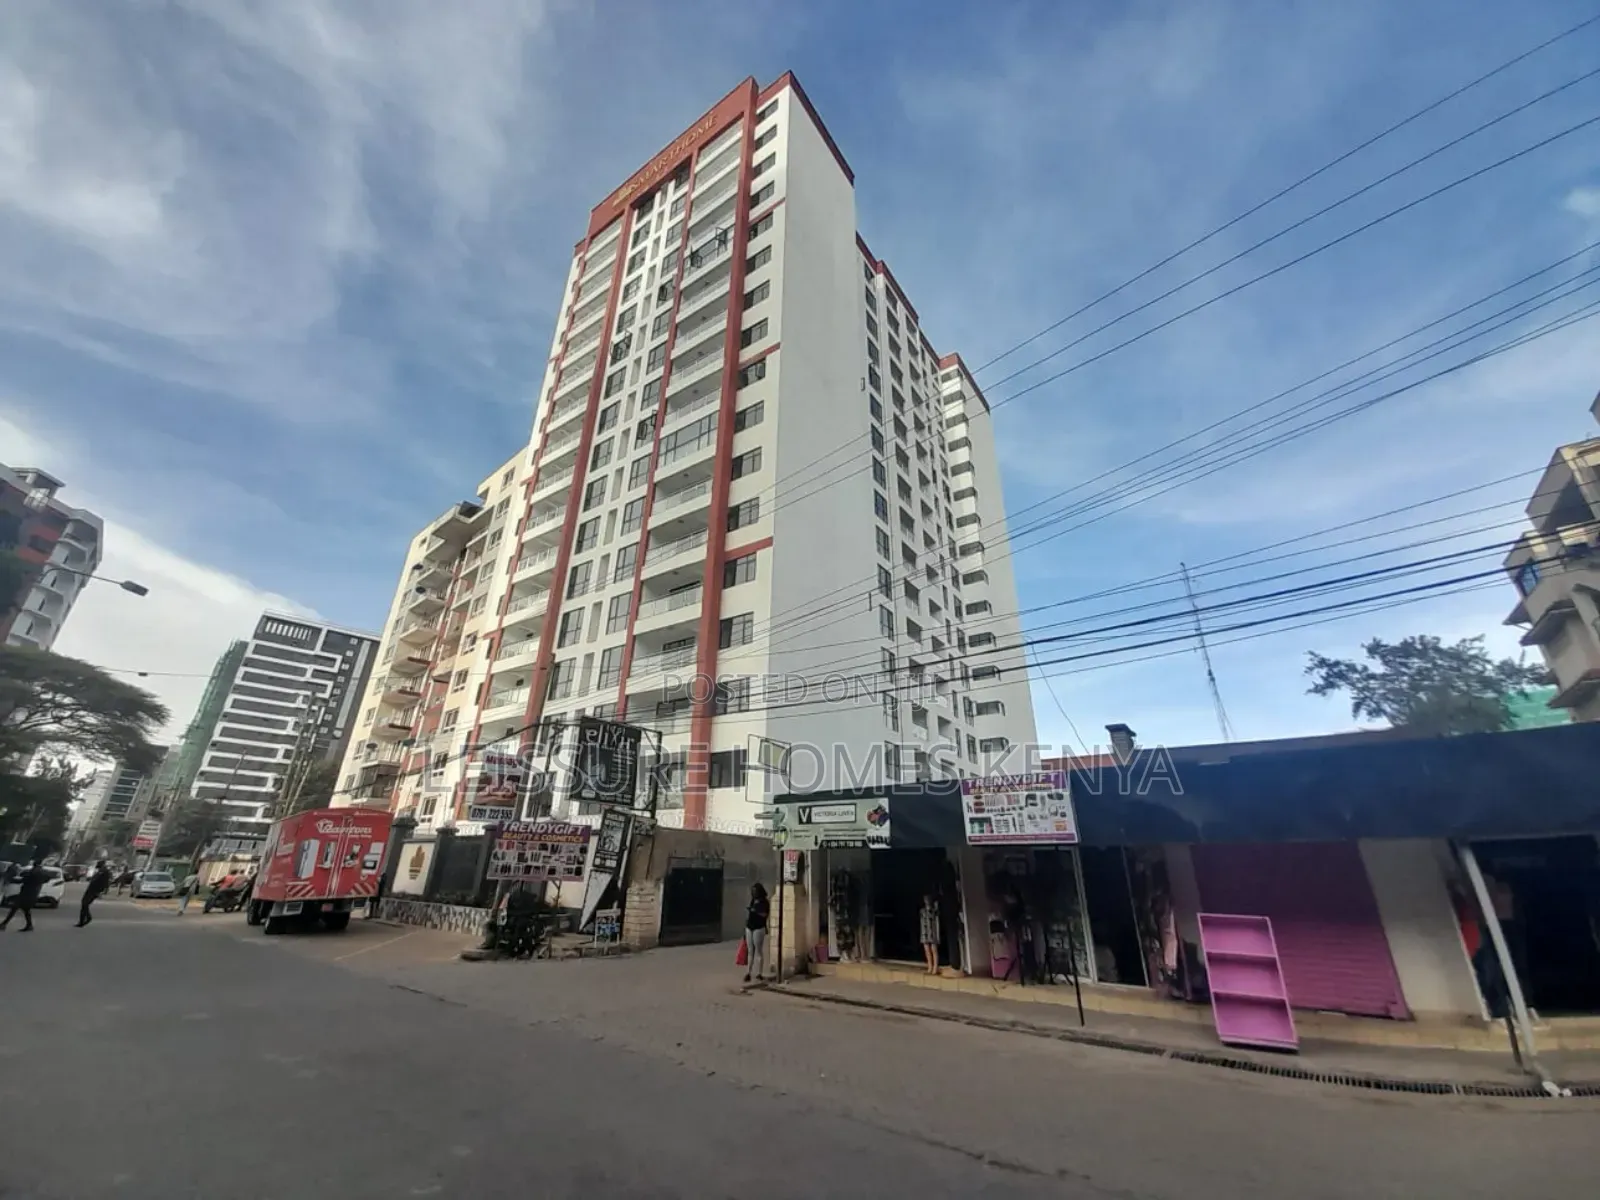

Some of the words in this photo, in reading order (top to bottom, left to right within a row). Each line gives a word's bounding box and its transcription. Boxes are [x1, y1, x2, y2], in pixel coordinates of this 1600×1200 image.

[799, 807, 811, 823] V
[502, 820, 586, 836] TRENDYGIFT
[503, 831, 533, 841] BEAUTY
